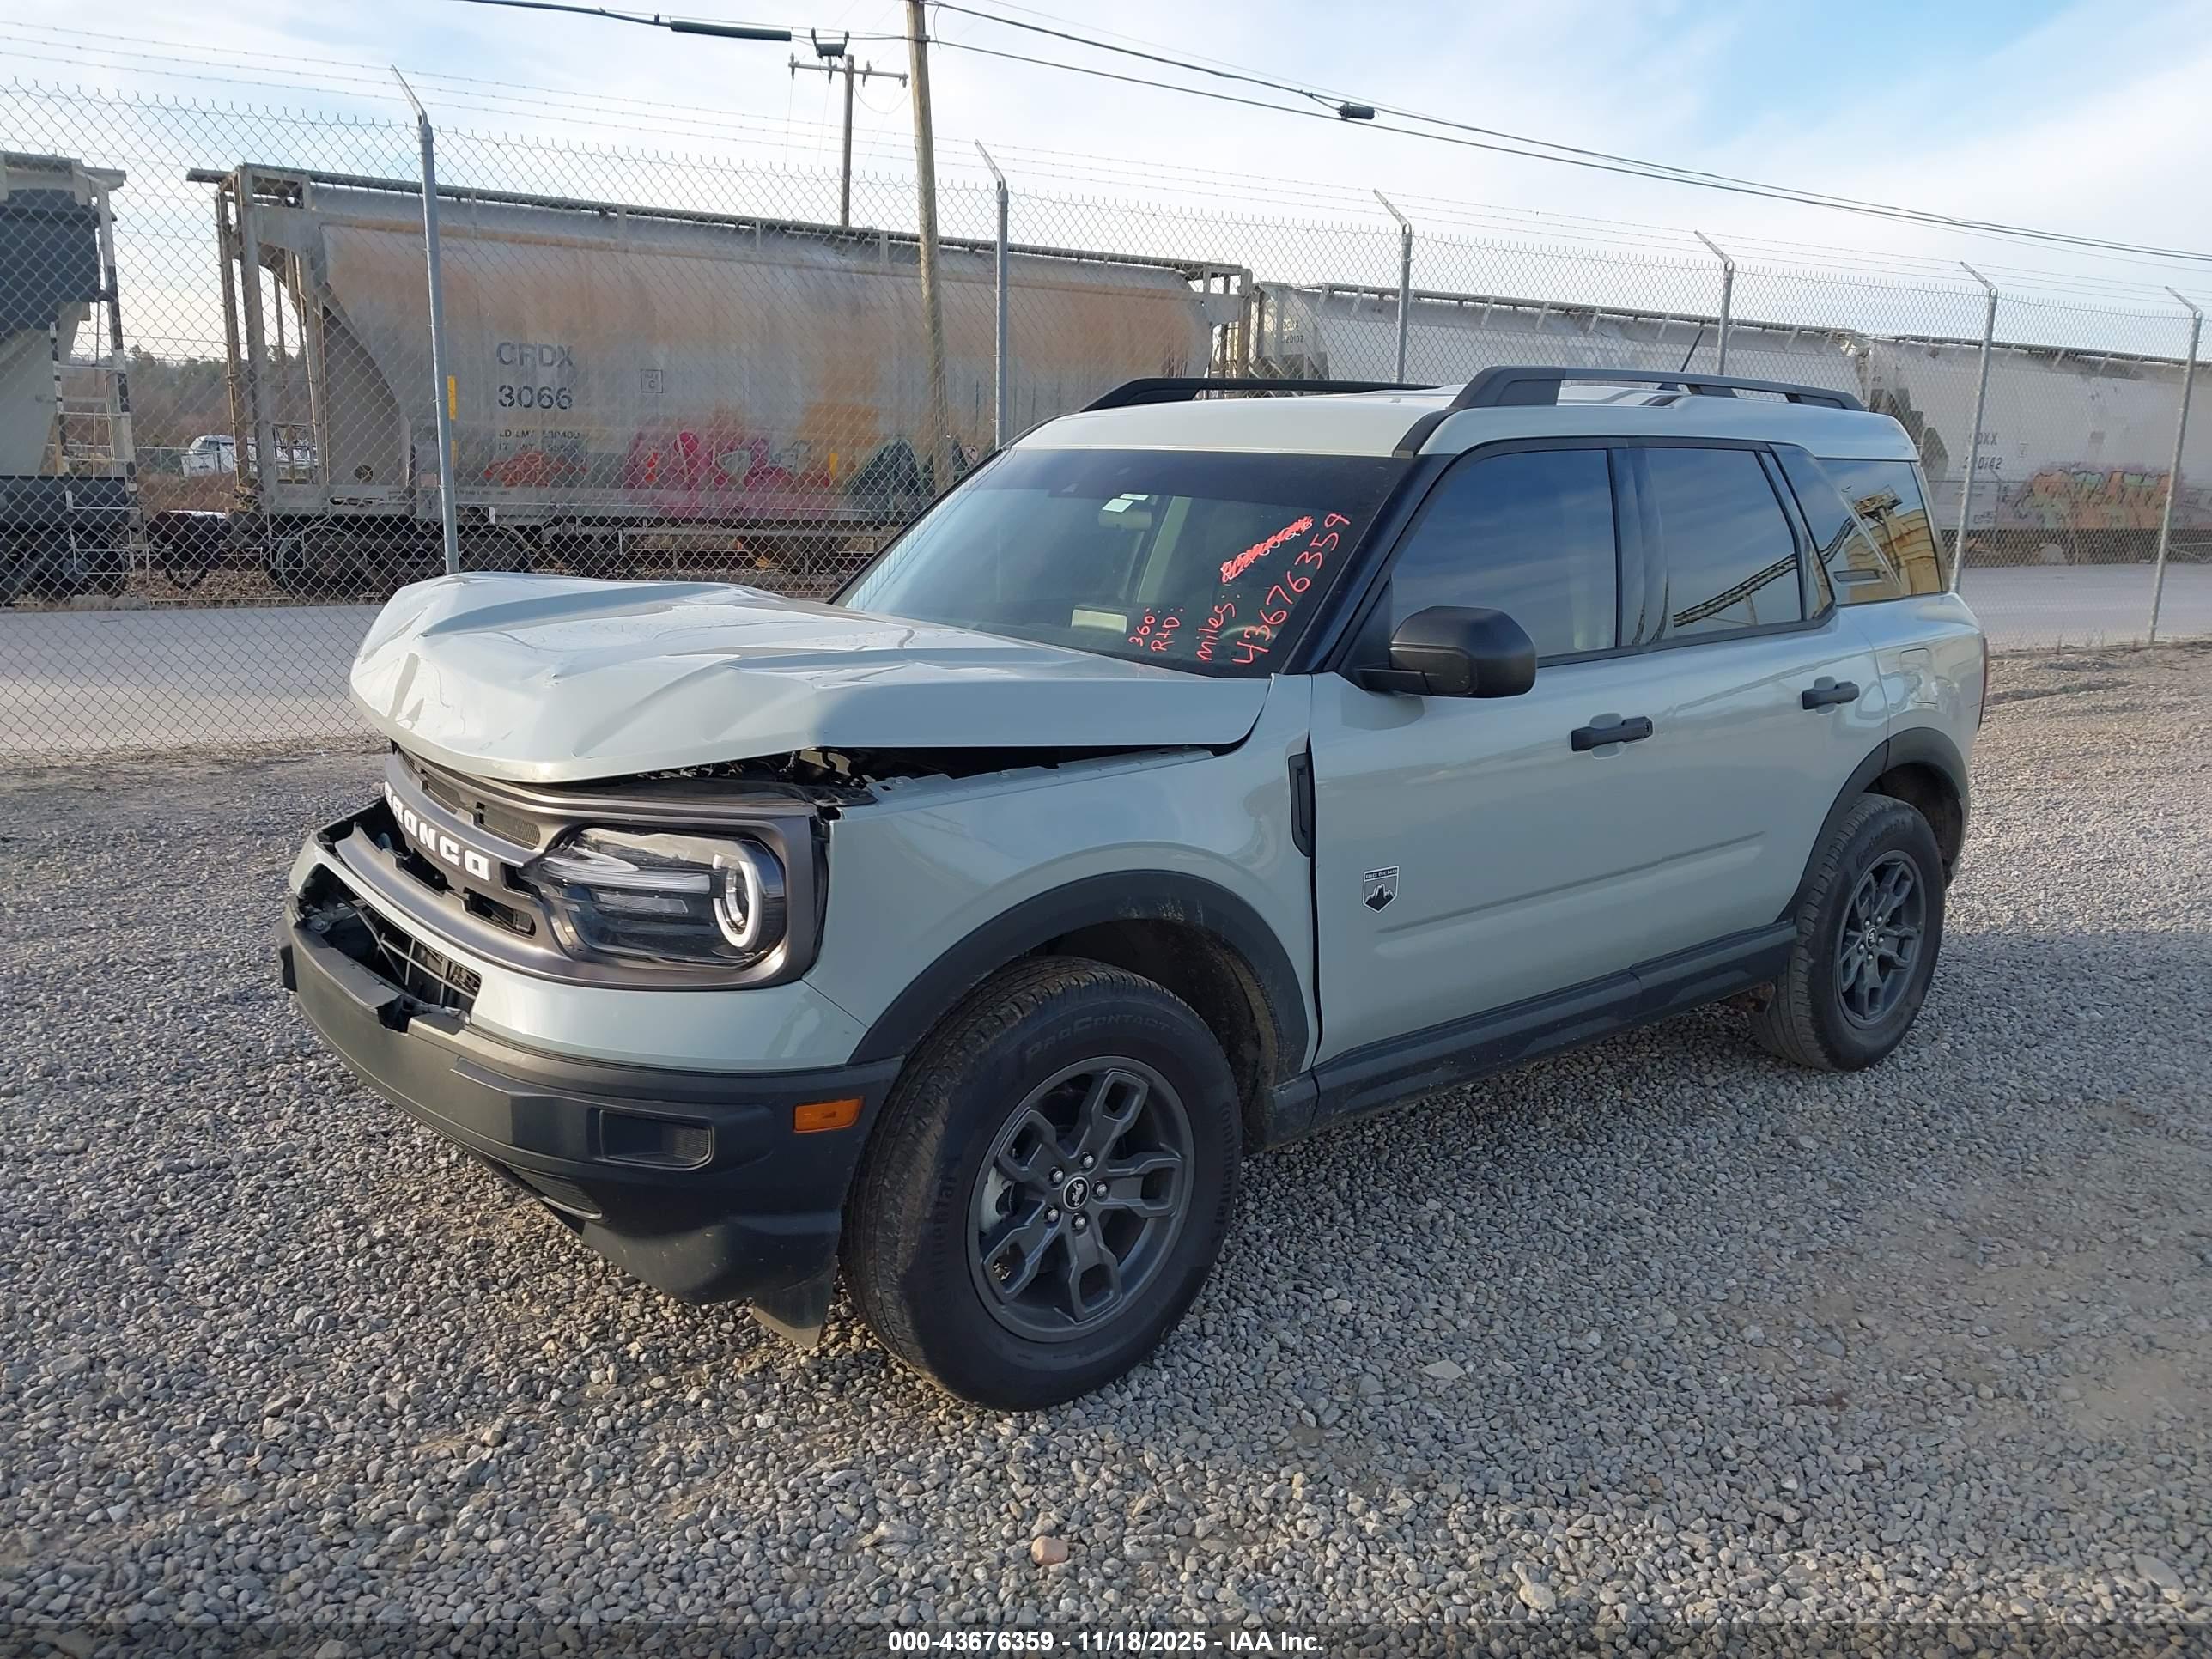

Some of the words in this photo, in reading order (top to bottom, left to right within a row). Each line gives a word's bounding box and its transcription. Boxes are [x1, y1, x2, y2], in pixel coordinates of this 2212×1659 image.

[497, 384, 573, 410] 3066
[1232, 513, 1352, 664] 43676359
[384, 781, 490, 882] BRONCO
